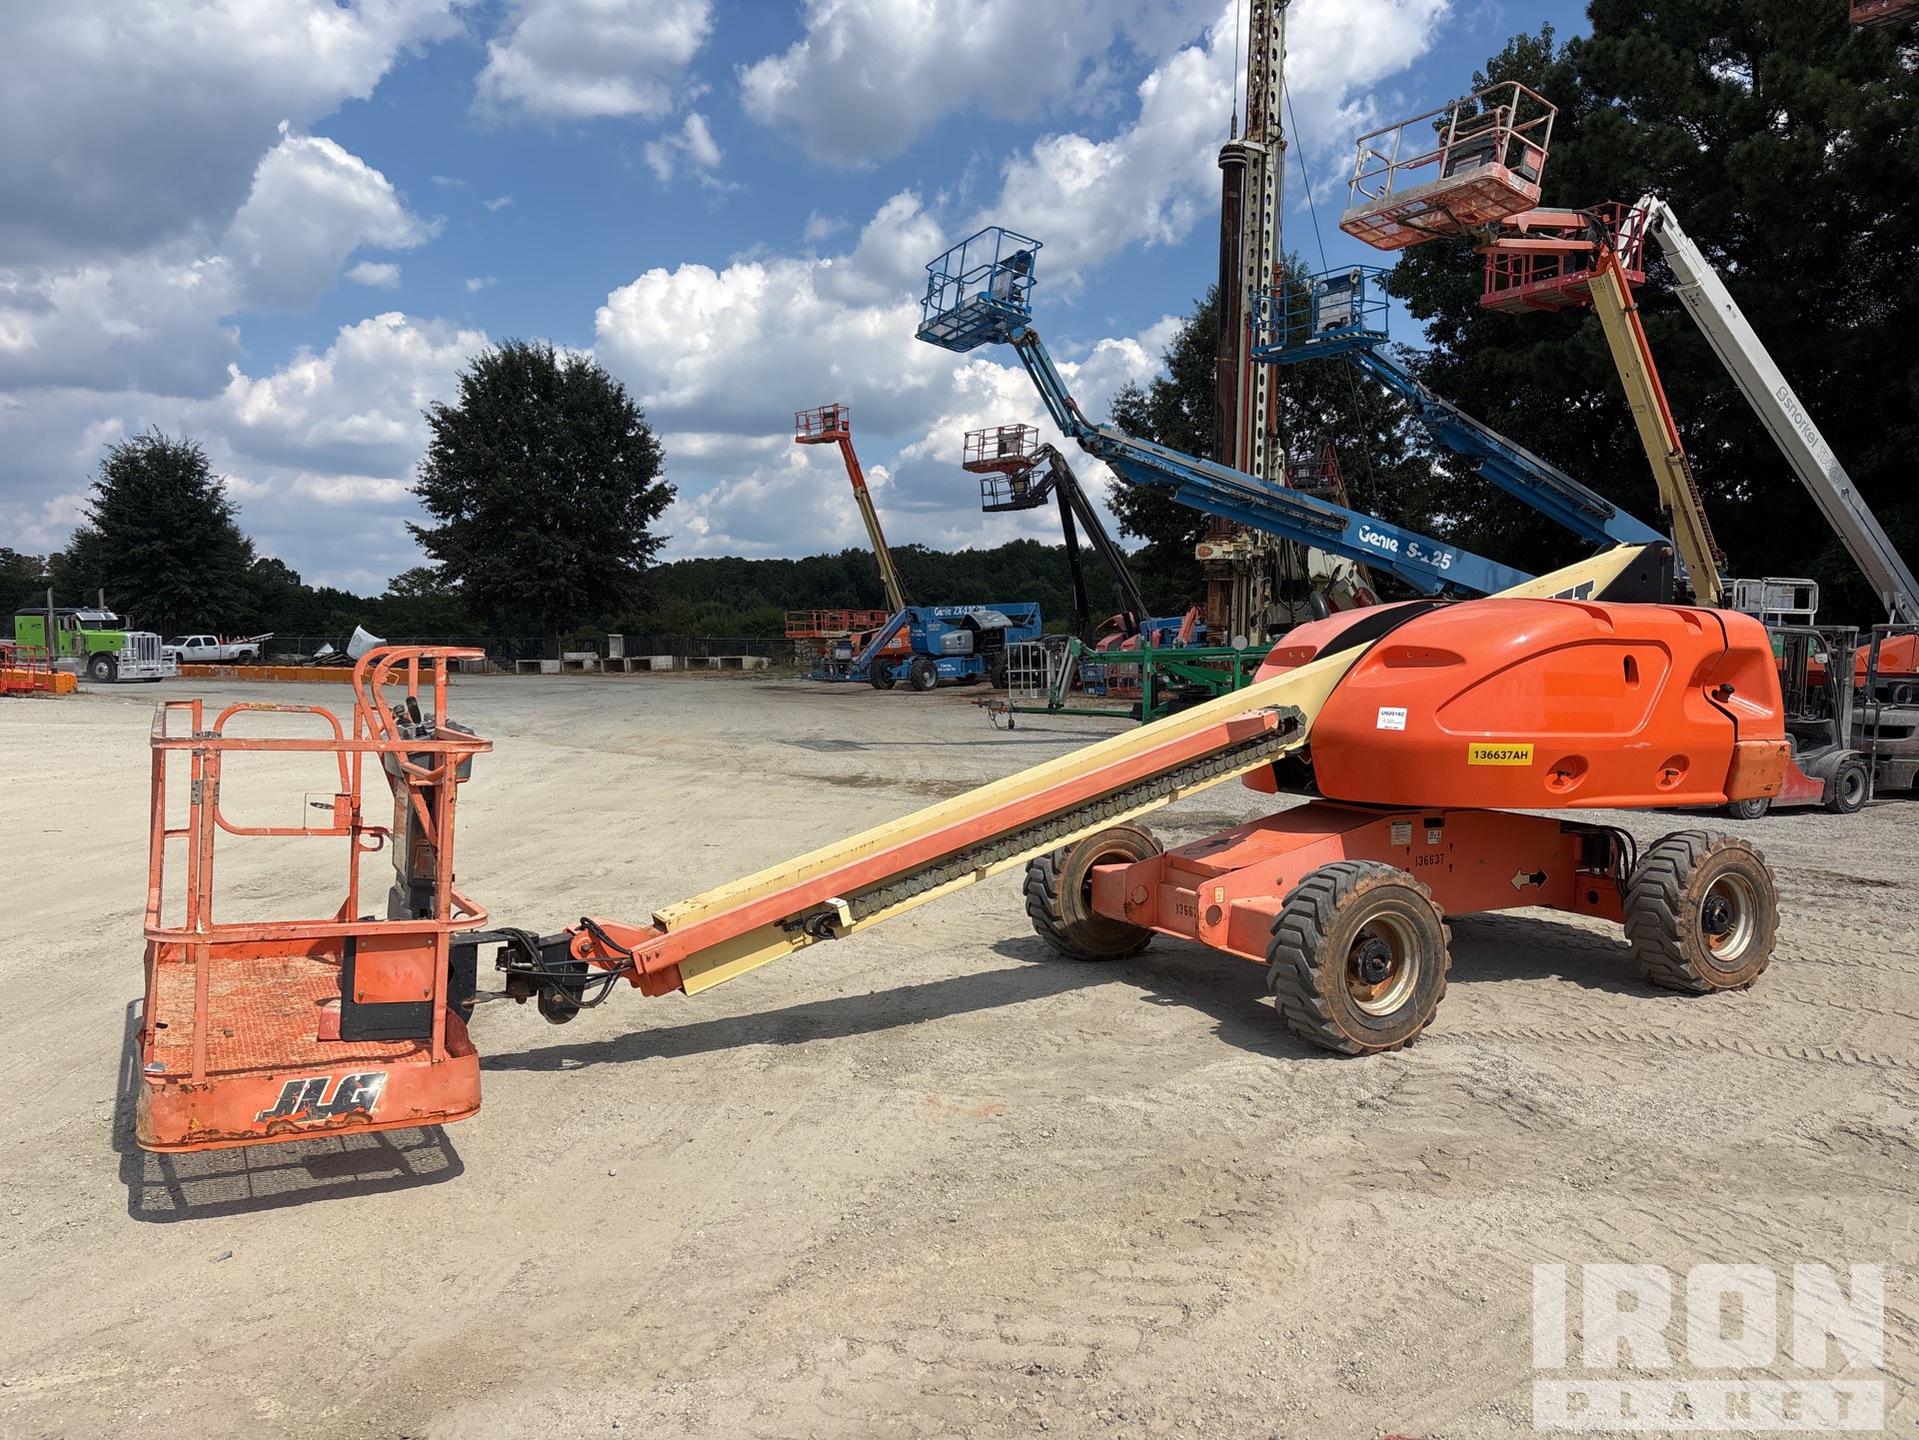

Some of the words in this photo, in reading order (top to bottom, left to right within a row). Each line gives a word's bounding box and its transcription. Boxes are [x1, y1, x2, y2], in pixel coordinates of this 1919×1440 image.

[1783, 398, 1819, 448] snorkel
[1358, 525, 1399, 552] Genie
[1474, 750, 1528, 760] 136637AH
[1415, 853, 1445, 867] 136637
[253, 1071, 389, 1124] JLG
